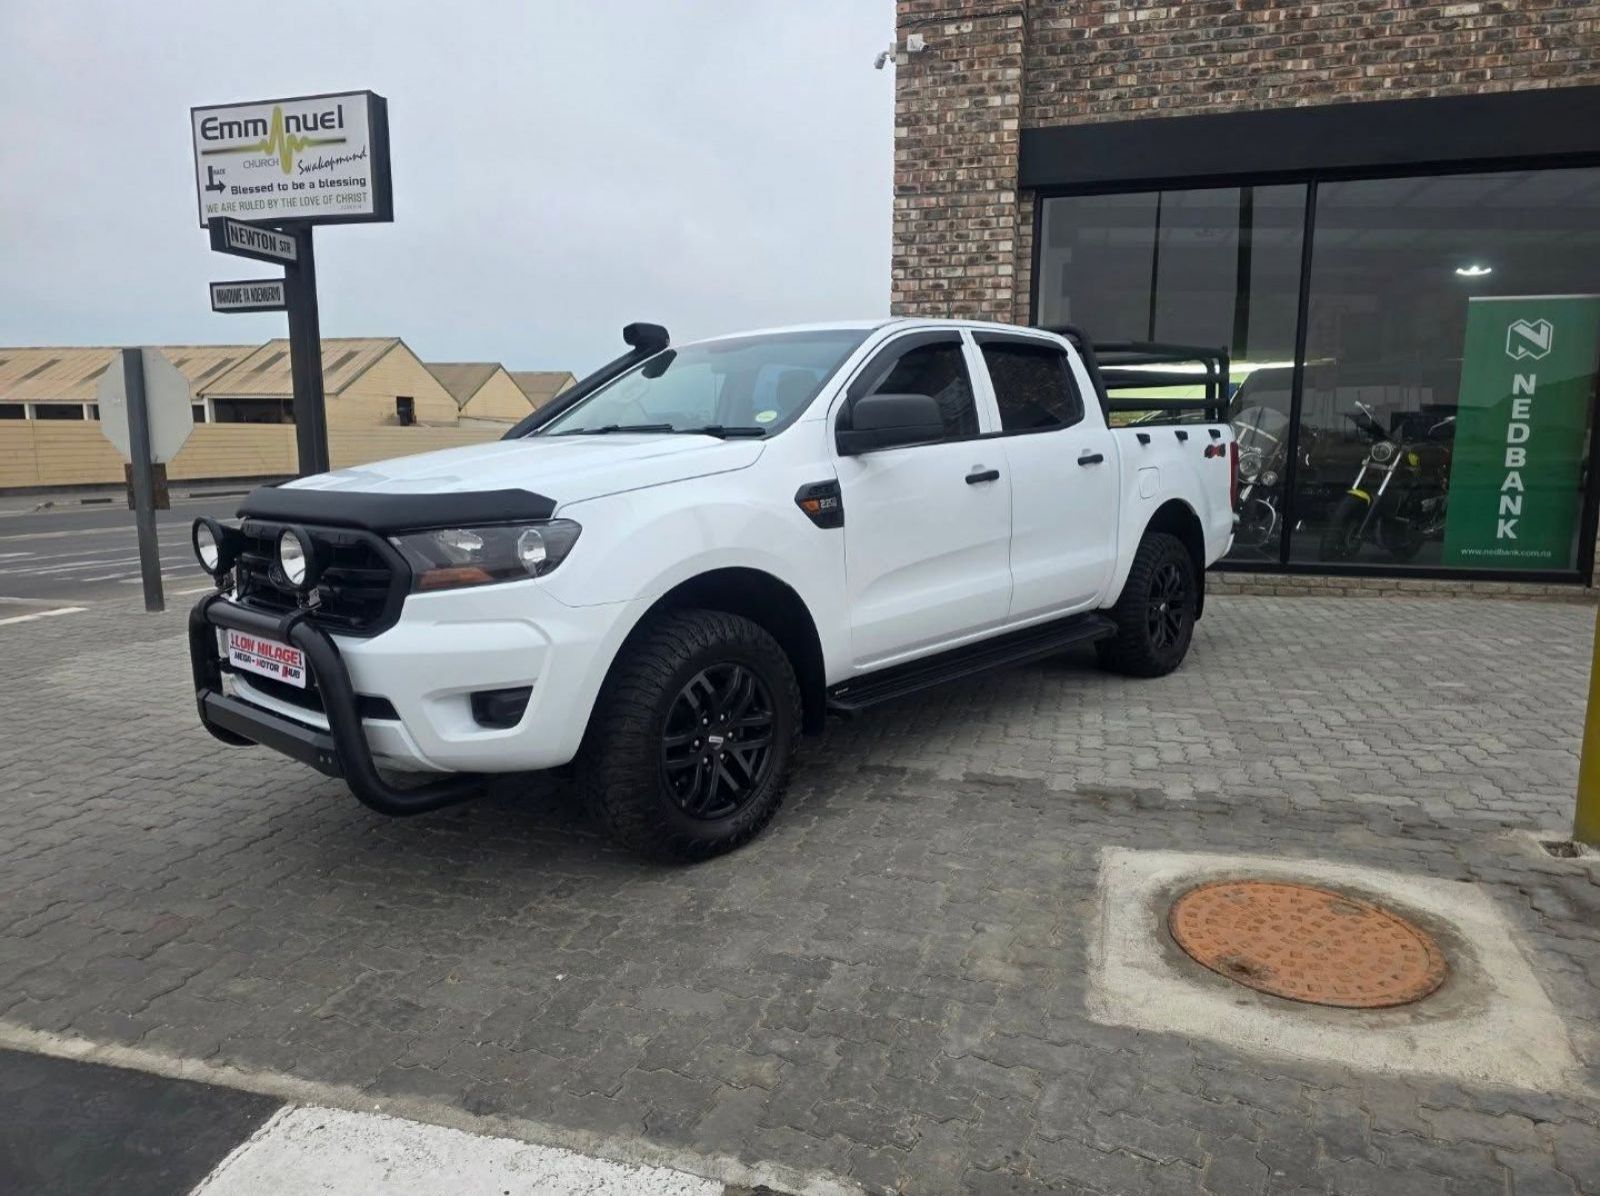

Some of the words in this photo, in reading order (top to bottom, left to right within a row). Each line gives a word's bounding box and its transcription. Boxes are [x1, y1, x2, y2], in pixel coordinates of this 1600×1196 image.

[243, 158, 279, 169] CHURCH
[298, 145, 367, 175] Swakopmund
[231, 185, 273, 195] Blessed
[278, 180, 289, 191] to
[292, 181, 305, 190] be
[309, 181, 315, 189] a
[319, 176, 366, 188] blessing
[207, 203, 219, 213] WE
[221, 201, 237, 212] ARE
[239, 199, 265, 211] RULED
[267, 199, 279, 209] BY
[281, 197, 297, 208] THE
[300, 195, 320, 207] LOVE
[322, 194, 333, 205] OF
[336, 192, 367, 204] CHRIST
[230, 225, 277, 251] NEWTON
[279, 240, 291, 254] STR
[1497, 374, 1536, 539] NEDBANK
